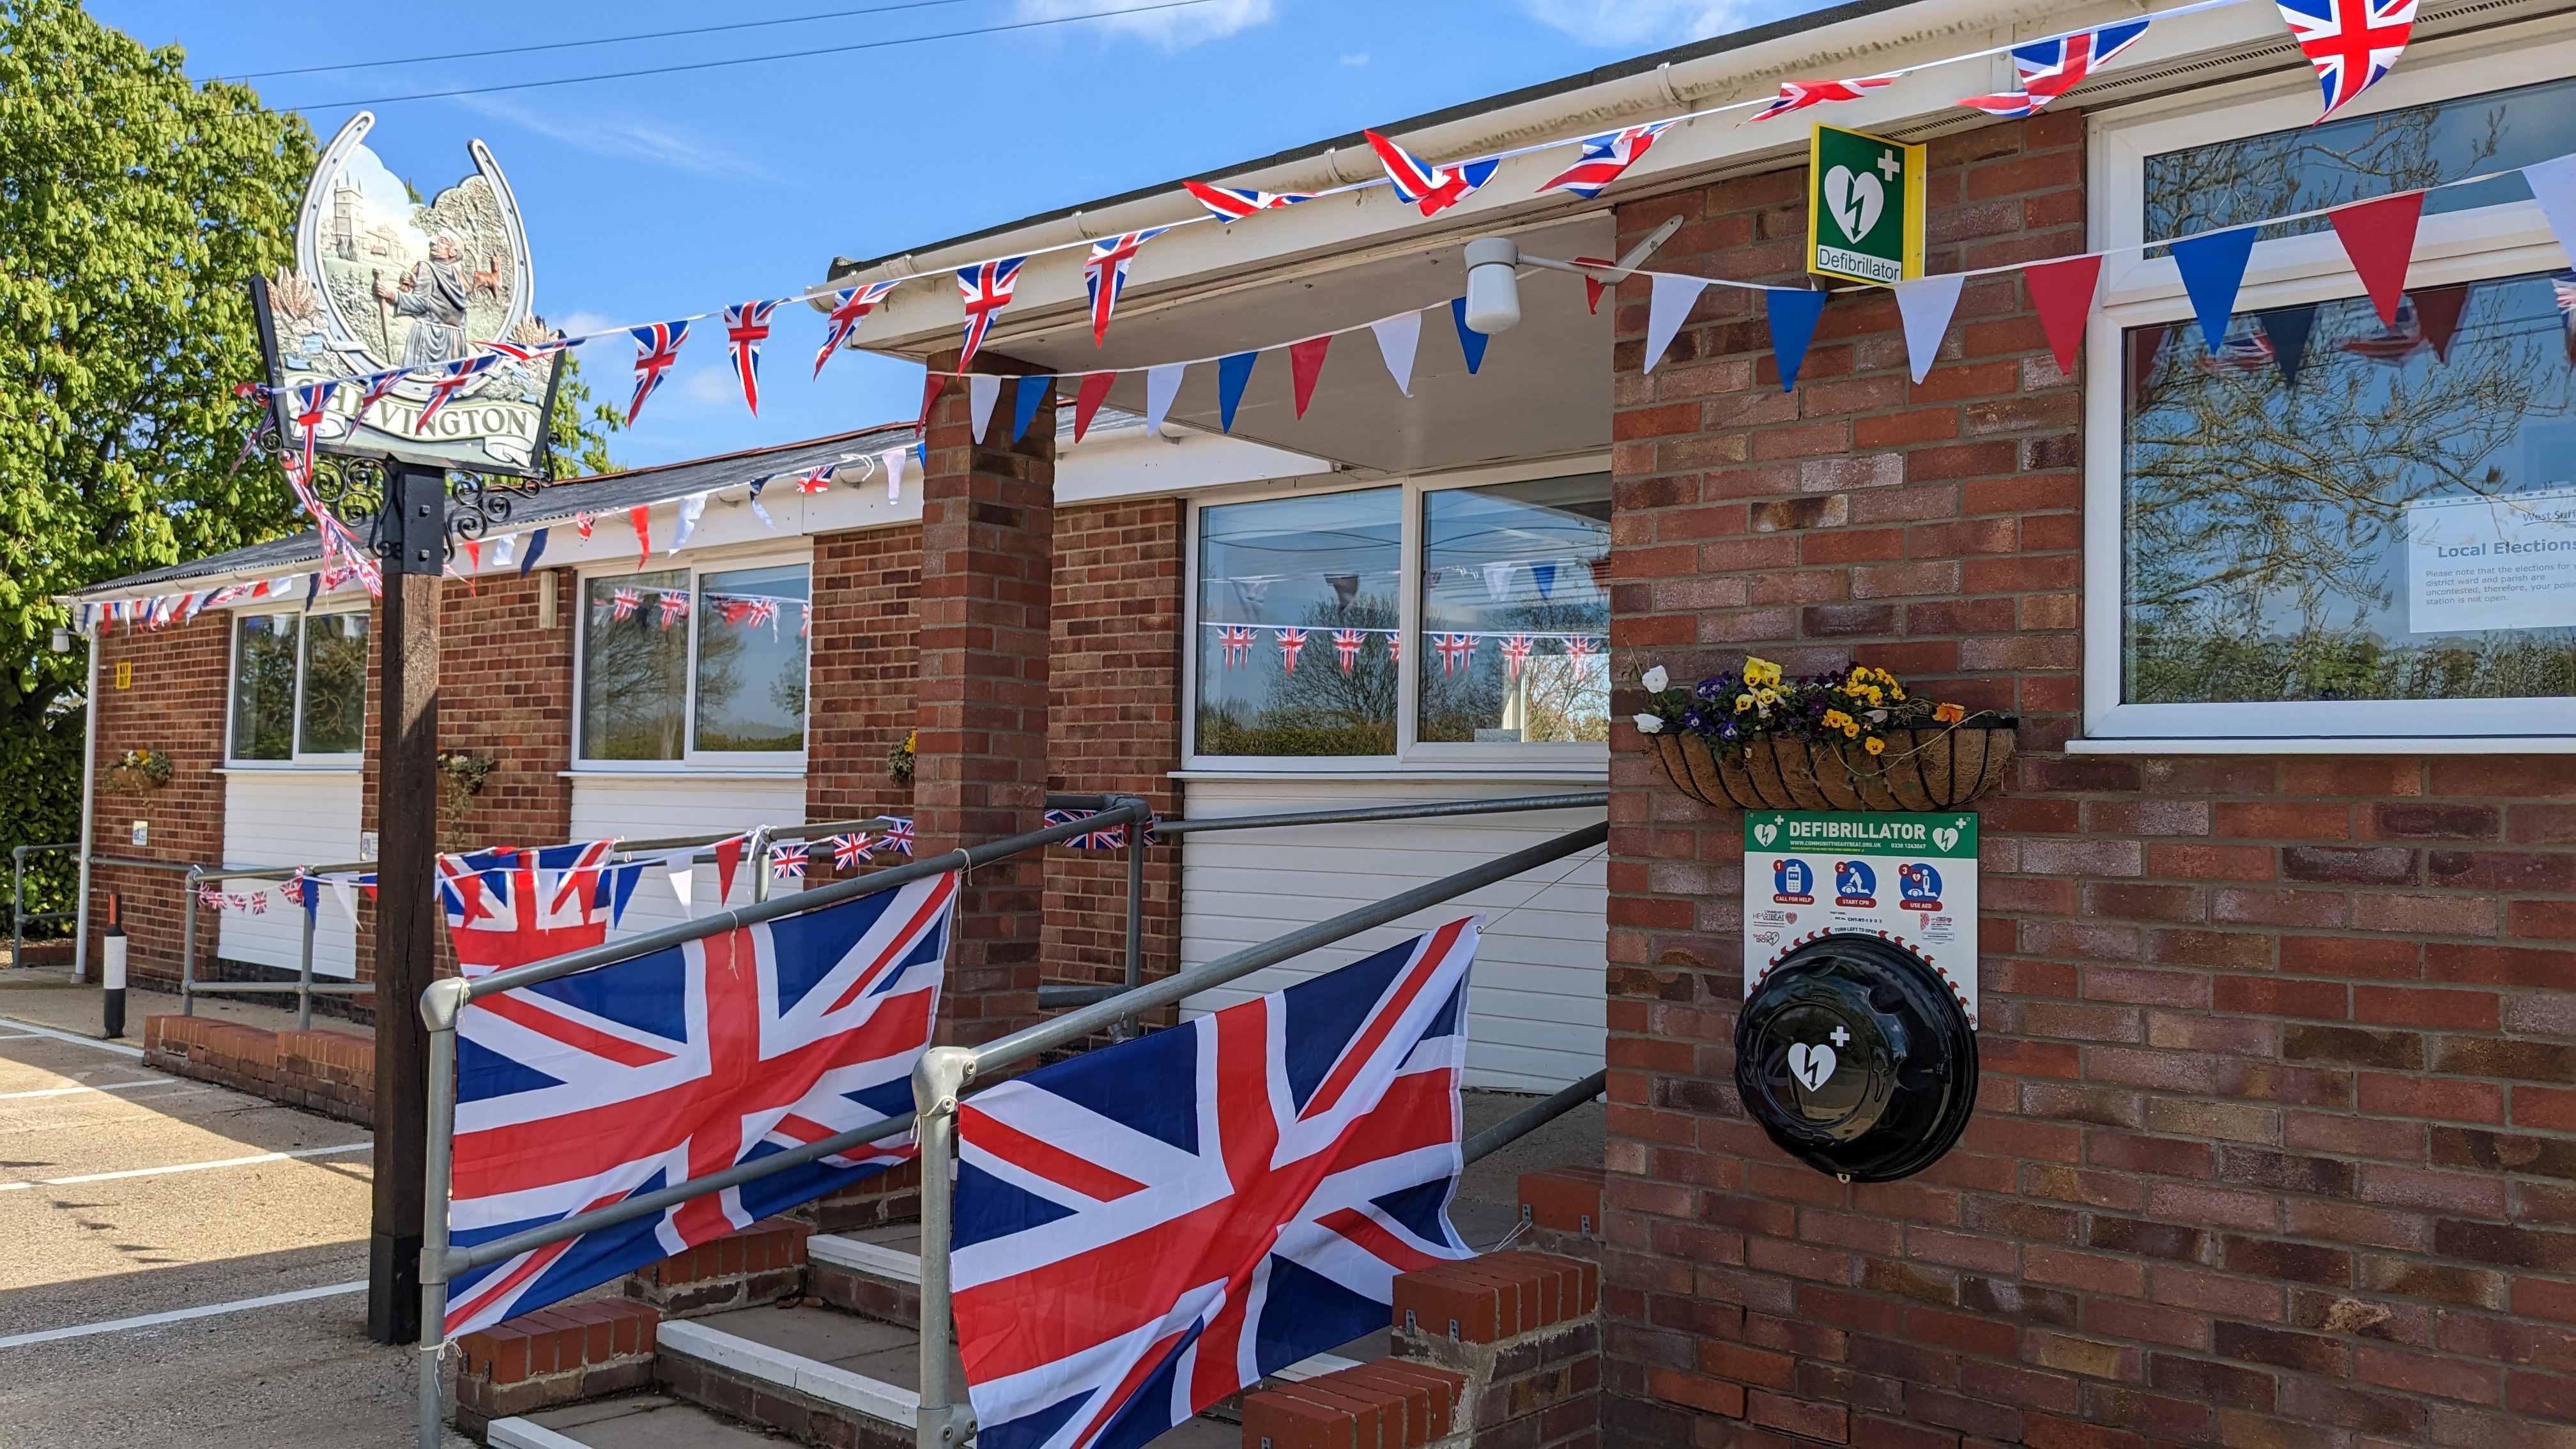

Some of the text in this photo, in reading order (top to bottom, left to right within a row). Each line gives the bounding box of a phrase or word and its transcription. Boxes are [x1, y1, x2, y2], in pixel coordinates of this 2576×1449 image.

[1820, 248, 1899, 280] Defibrillator
[2438, 543, 2486, 558] Local
[2515, 564, 2554, 572] elections
[2501, 574, 2528, 583] parish
[2426, 587, 2481, 596] uncontested,
[2484, 584, 2527, 593] therefore,
[2485, 595, 2509, 603] open.
[1790, 822, 1926, 840] DEFIBRILLATOR
[1902, 866, 1908, 875] 3
